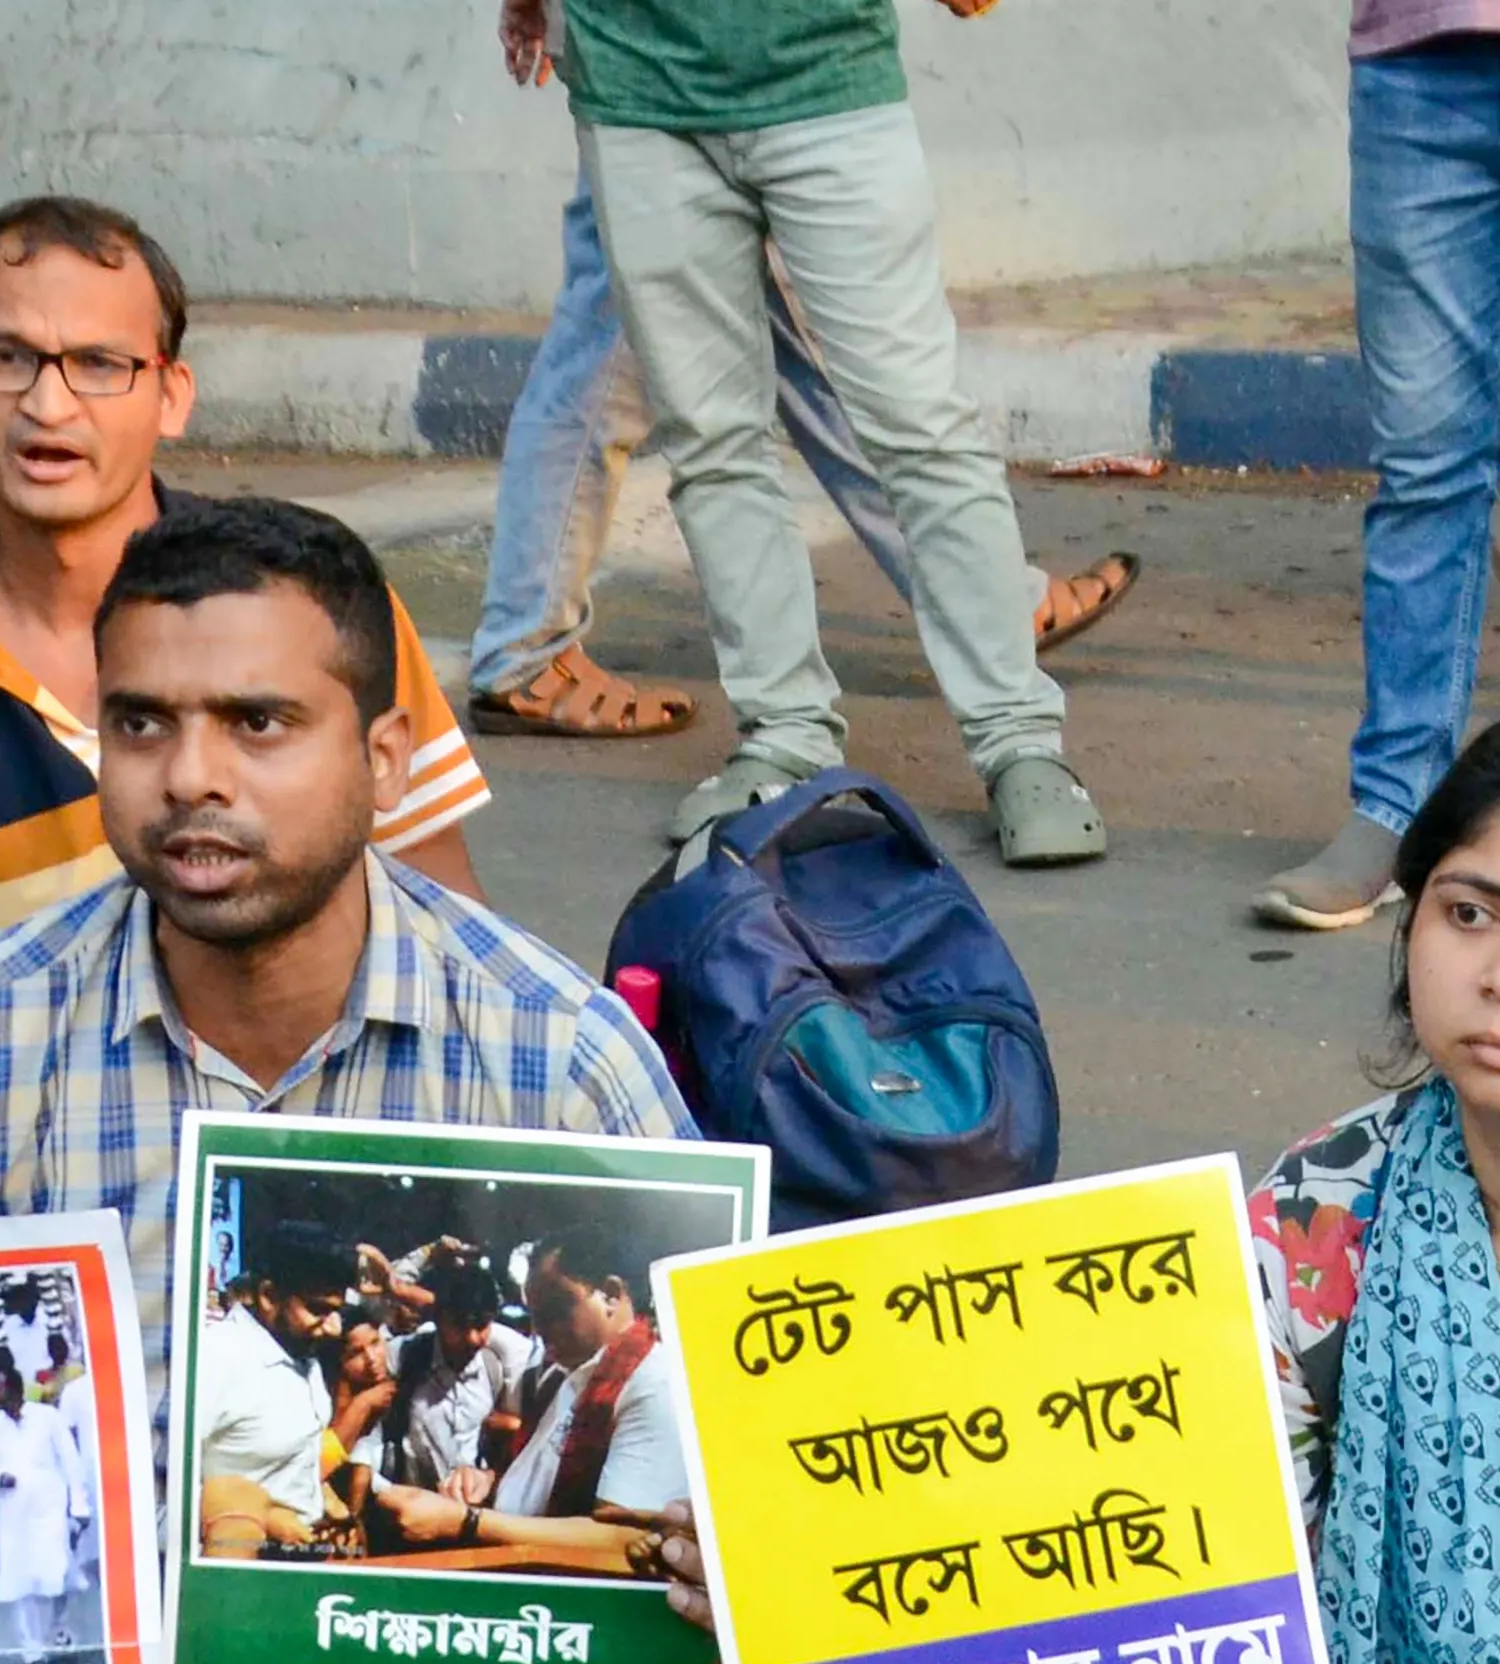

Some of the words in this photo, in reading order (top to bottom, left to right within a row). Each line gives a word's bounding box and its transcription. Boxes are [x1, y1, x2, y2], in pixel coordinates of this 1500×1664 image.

[735, 1275, 855, 1376] টেট
[886, 1263, 1023, 1344] পাস
[1047, 1233, 1194, 1311] করে
[789, 1405, 1008, 1494] আজও
[1039, 1359, 1181, 1451] পথে
[834, 1542, 979, 1623] বসে
